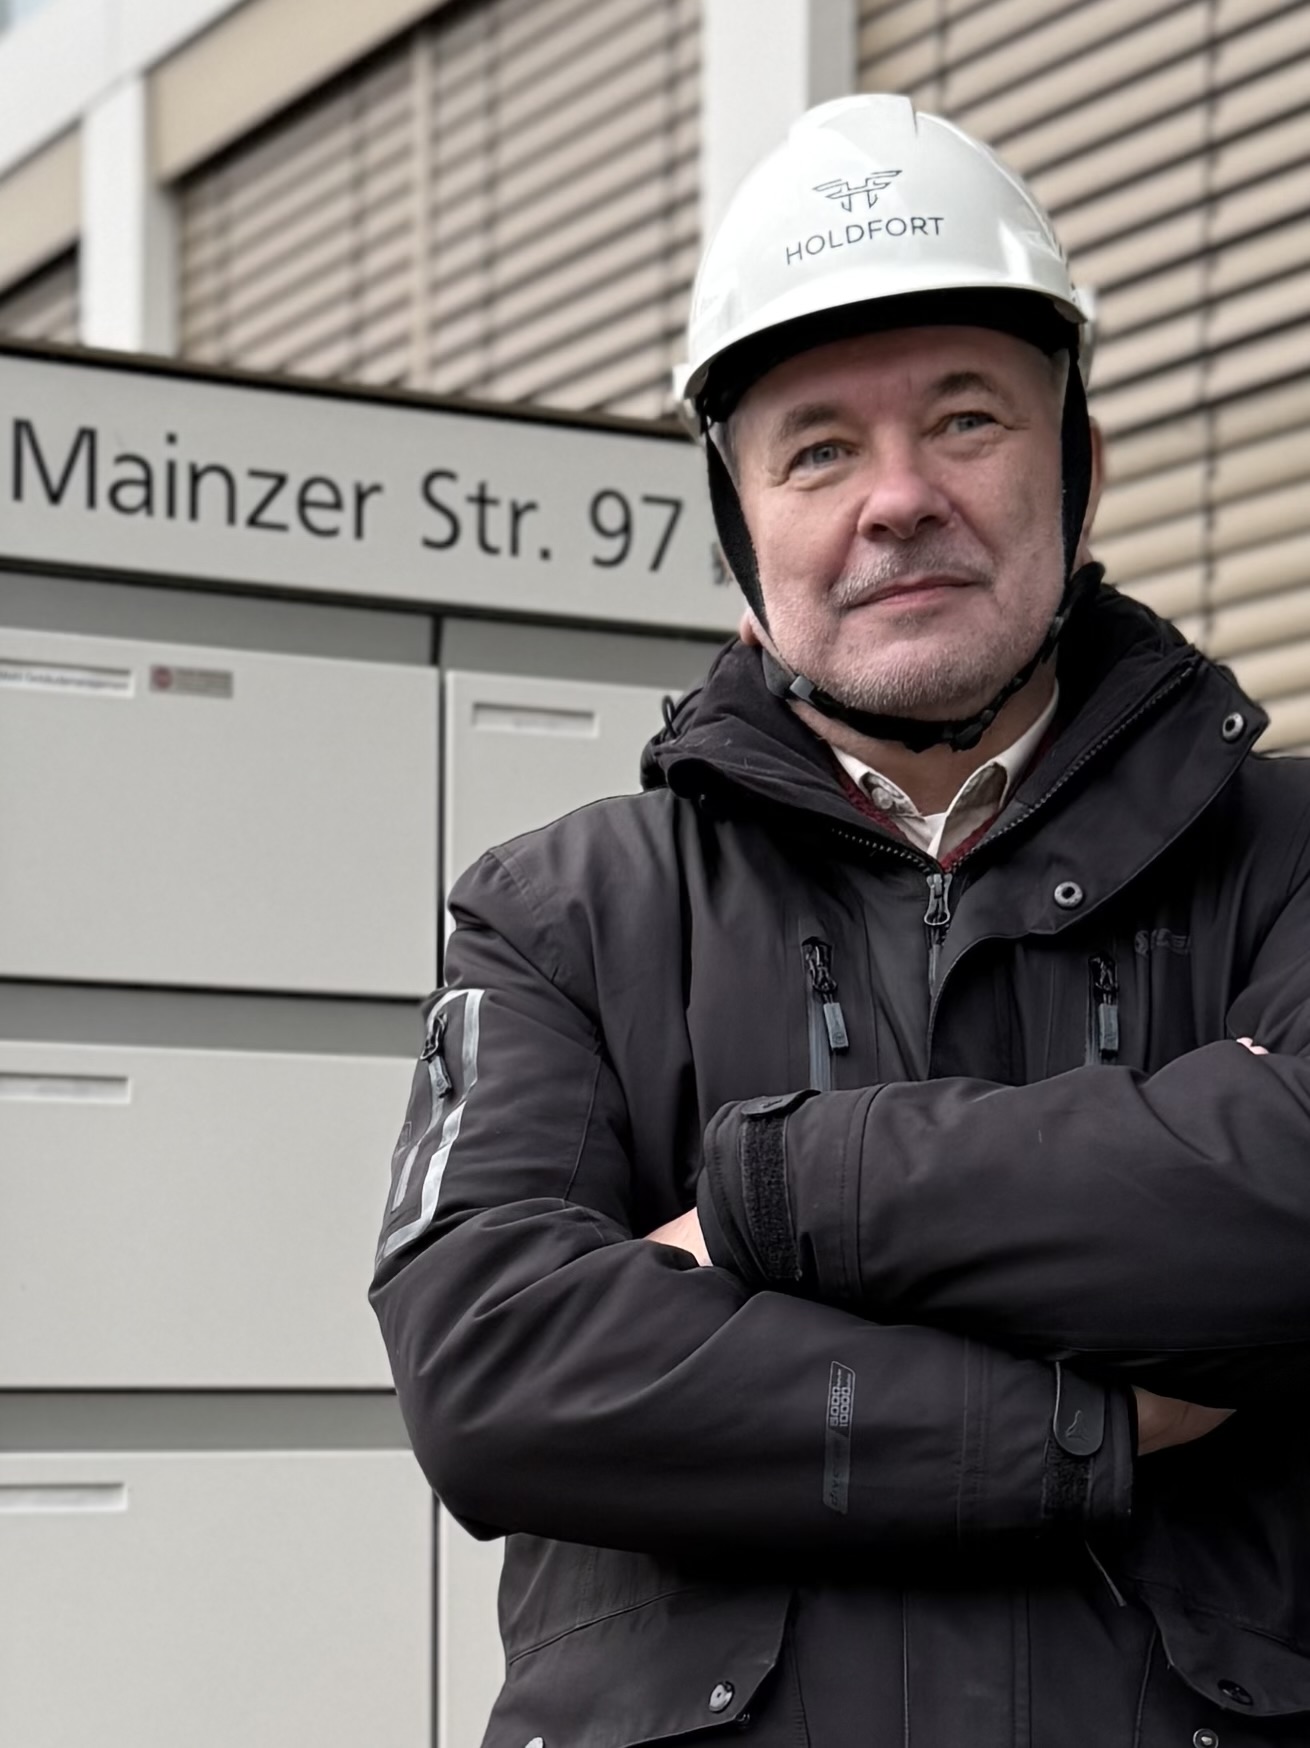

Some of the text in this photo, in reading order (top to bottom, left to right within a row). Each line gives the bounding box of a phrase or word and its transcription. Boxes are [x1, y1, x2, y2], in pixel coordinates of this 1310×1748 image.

[786, 217, 944, 264] HOLDFORT
[12, 417, 383, 541] Mainzer
[420, 468, 551, 561] Str.
[589, 488, 684, 572] 97
